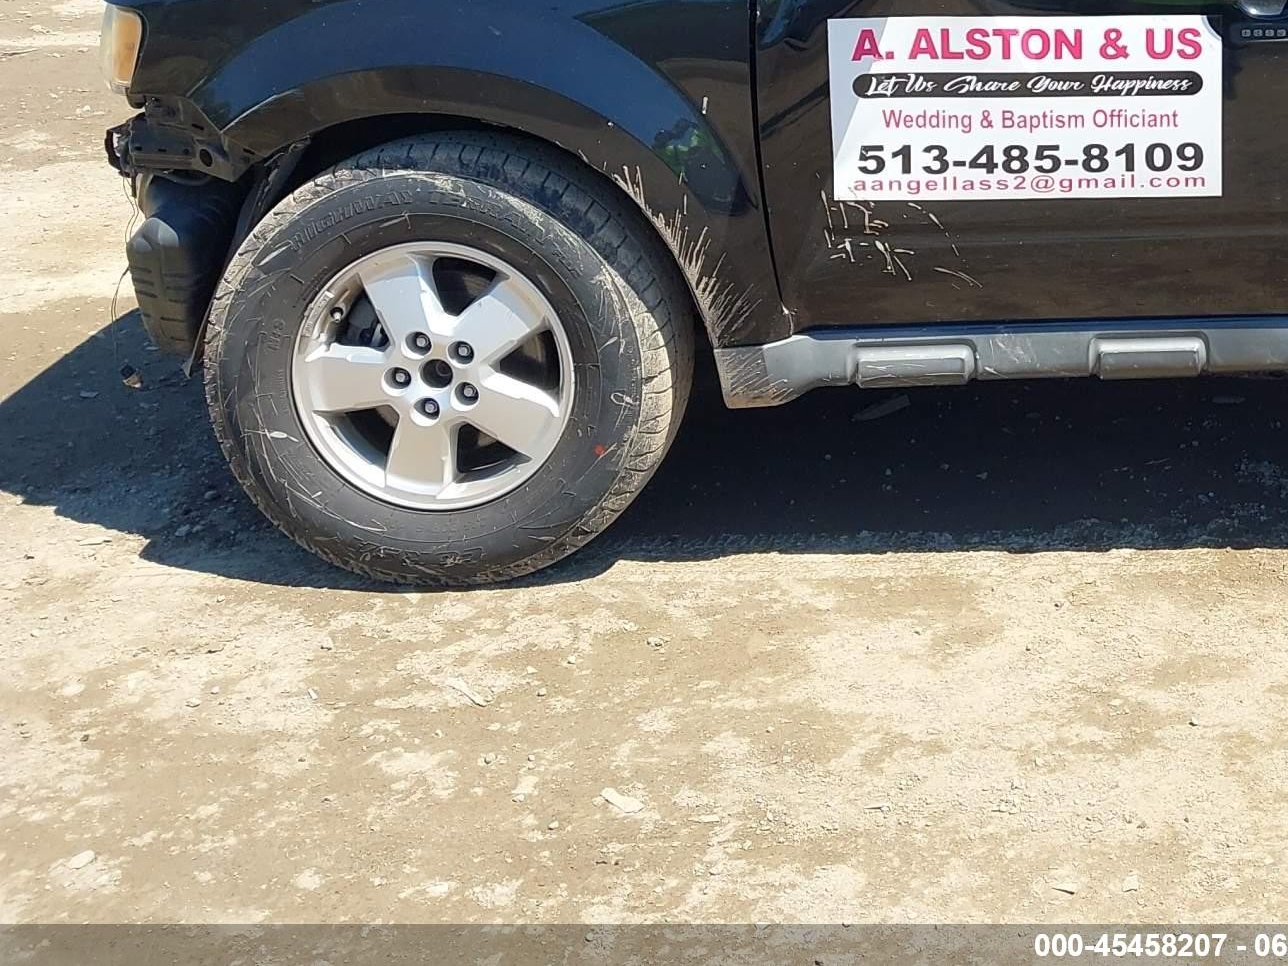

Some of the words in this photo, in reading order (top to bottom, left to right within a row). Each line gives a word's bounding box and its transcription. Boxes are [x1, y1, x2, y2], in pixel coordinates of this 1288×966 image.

[851, 28, 895, 62] A.
[908, 27, 1084, 61] ALSTON
[1099, 27, 1130, 60] &
[1145, 27, 1203, 60] US
[865, 73, 904, 96] Let
[906, 73, 936, 94] Us
[943, 73, 1021, 93] Share
[1026, 74, 1084, 93] Your
[1089, 74, 1193, 96] Happiness
[882, 109, 973, 133] Wedding
[980, 109, 994, 130] &
[1001, 109, 1086, 133] Baptism
[1092, 108, 1179, 129] Officiant
[857, 142, 1205, 175] 513-485-8109
[853, 175, 1207, 195] aangellass2@gmail.com
